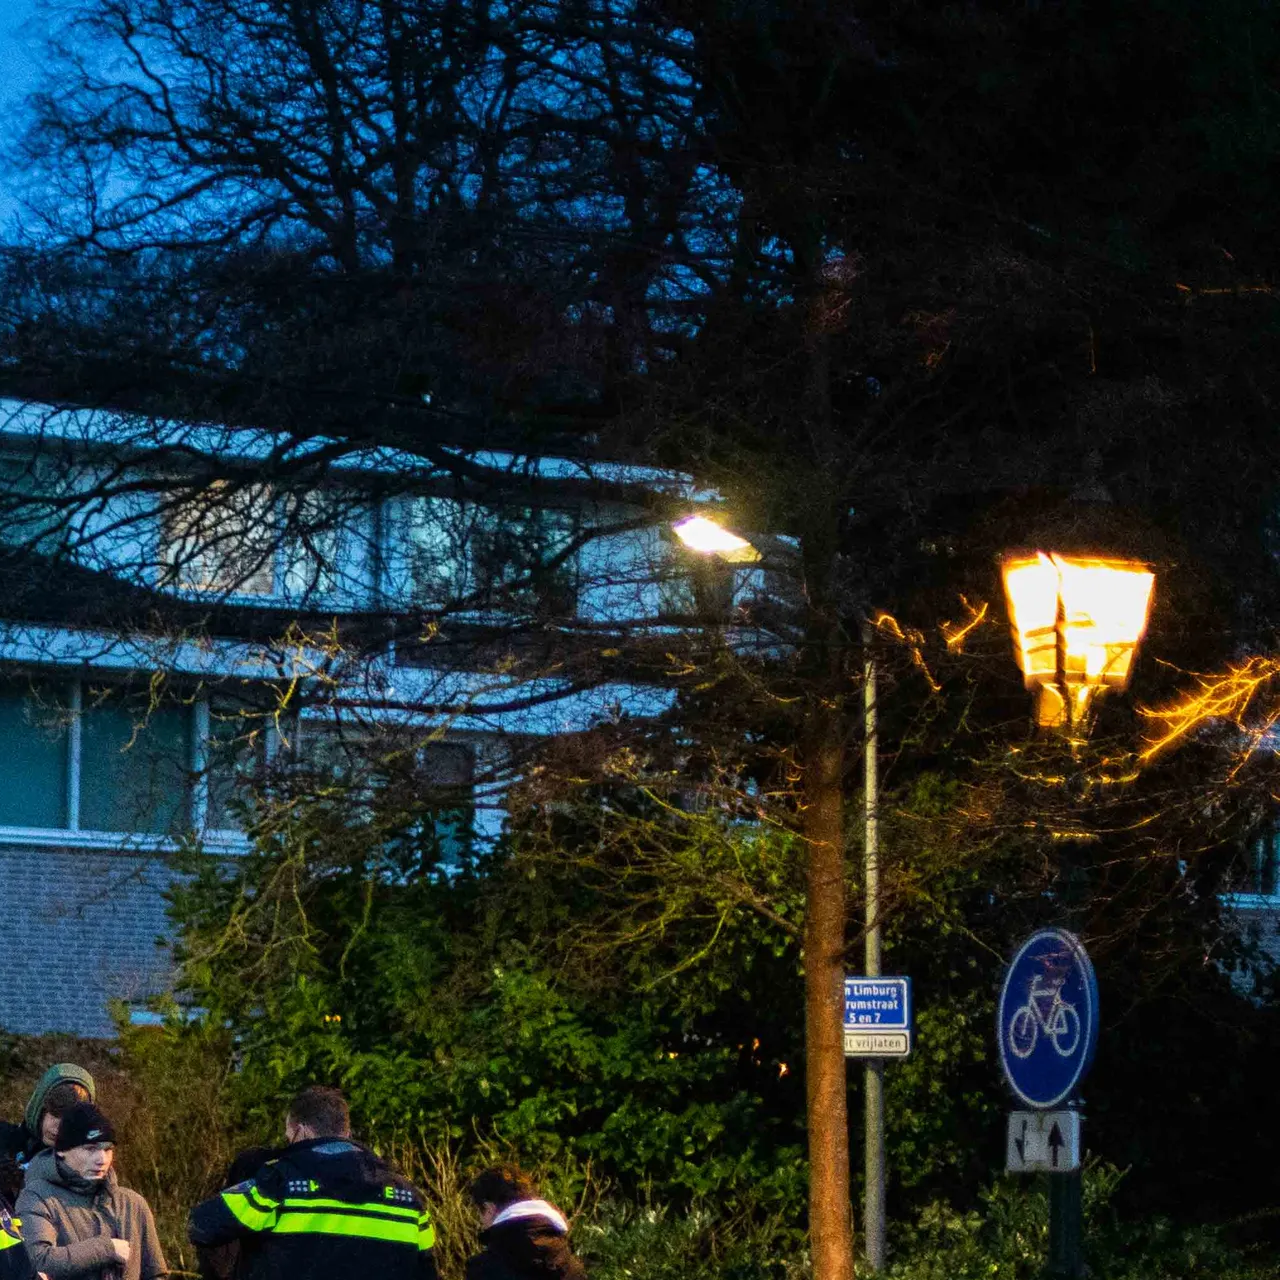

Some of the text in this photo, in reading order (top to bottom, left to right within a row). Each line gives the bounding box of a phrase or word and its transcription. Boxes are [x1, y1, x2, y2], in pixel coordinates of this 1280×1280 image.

[853, 985, 897, 998] Limburg
[845, 1000, 899, 1010] rumstraat
[849, 1013, 881, 1023] 5 en 7
[856, 1036, 901, 1050] vrijlaten
